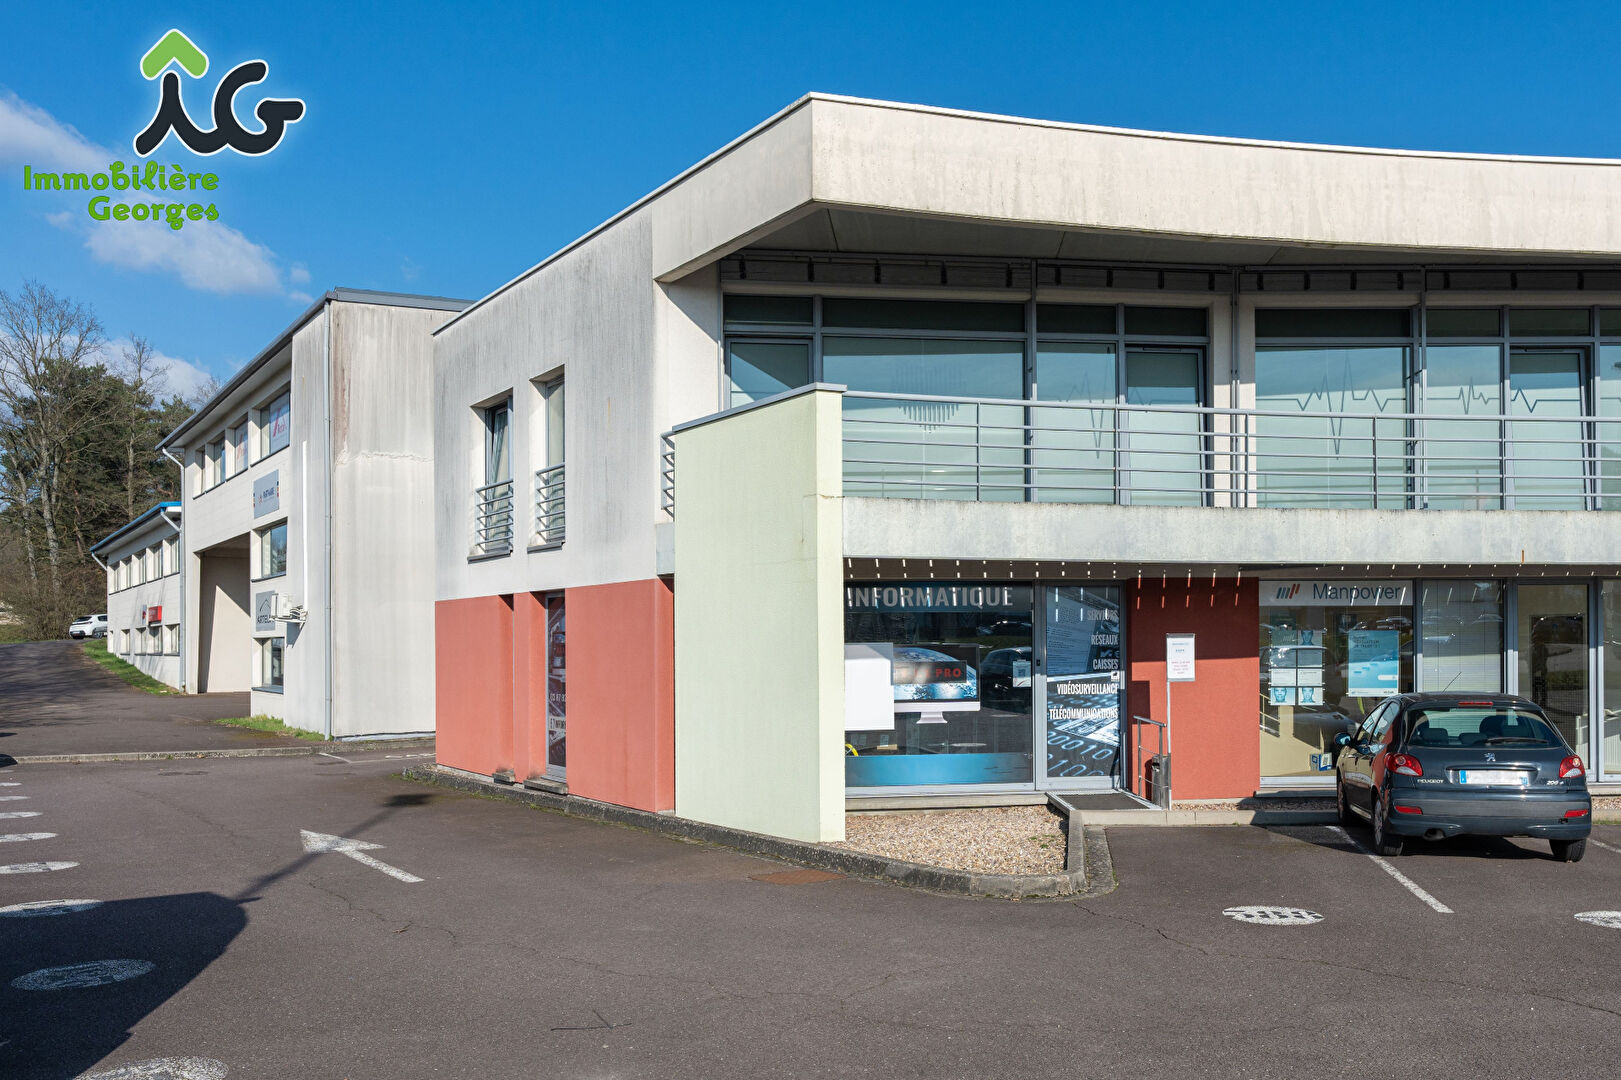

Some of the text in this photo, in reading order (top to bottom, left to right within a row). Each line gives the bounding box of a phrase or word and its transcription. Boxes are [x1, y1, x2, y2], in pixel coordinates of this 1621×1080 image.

[848, 586, 1013, 609] INFORMATIQUE
[1312, 582, 1401, 605] Manpower
[1091, 631, 1119, 645] RÉSEAUX
[1092, 658, 1119, 670] CAISSES
[935, 668, 962, 678] PRO
[1056, 681, 1119, 695] VIDÉOSURVEILLANCE
[1048, 705, 1119, 720] TÉLÉCOMMUNICATIONS
